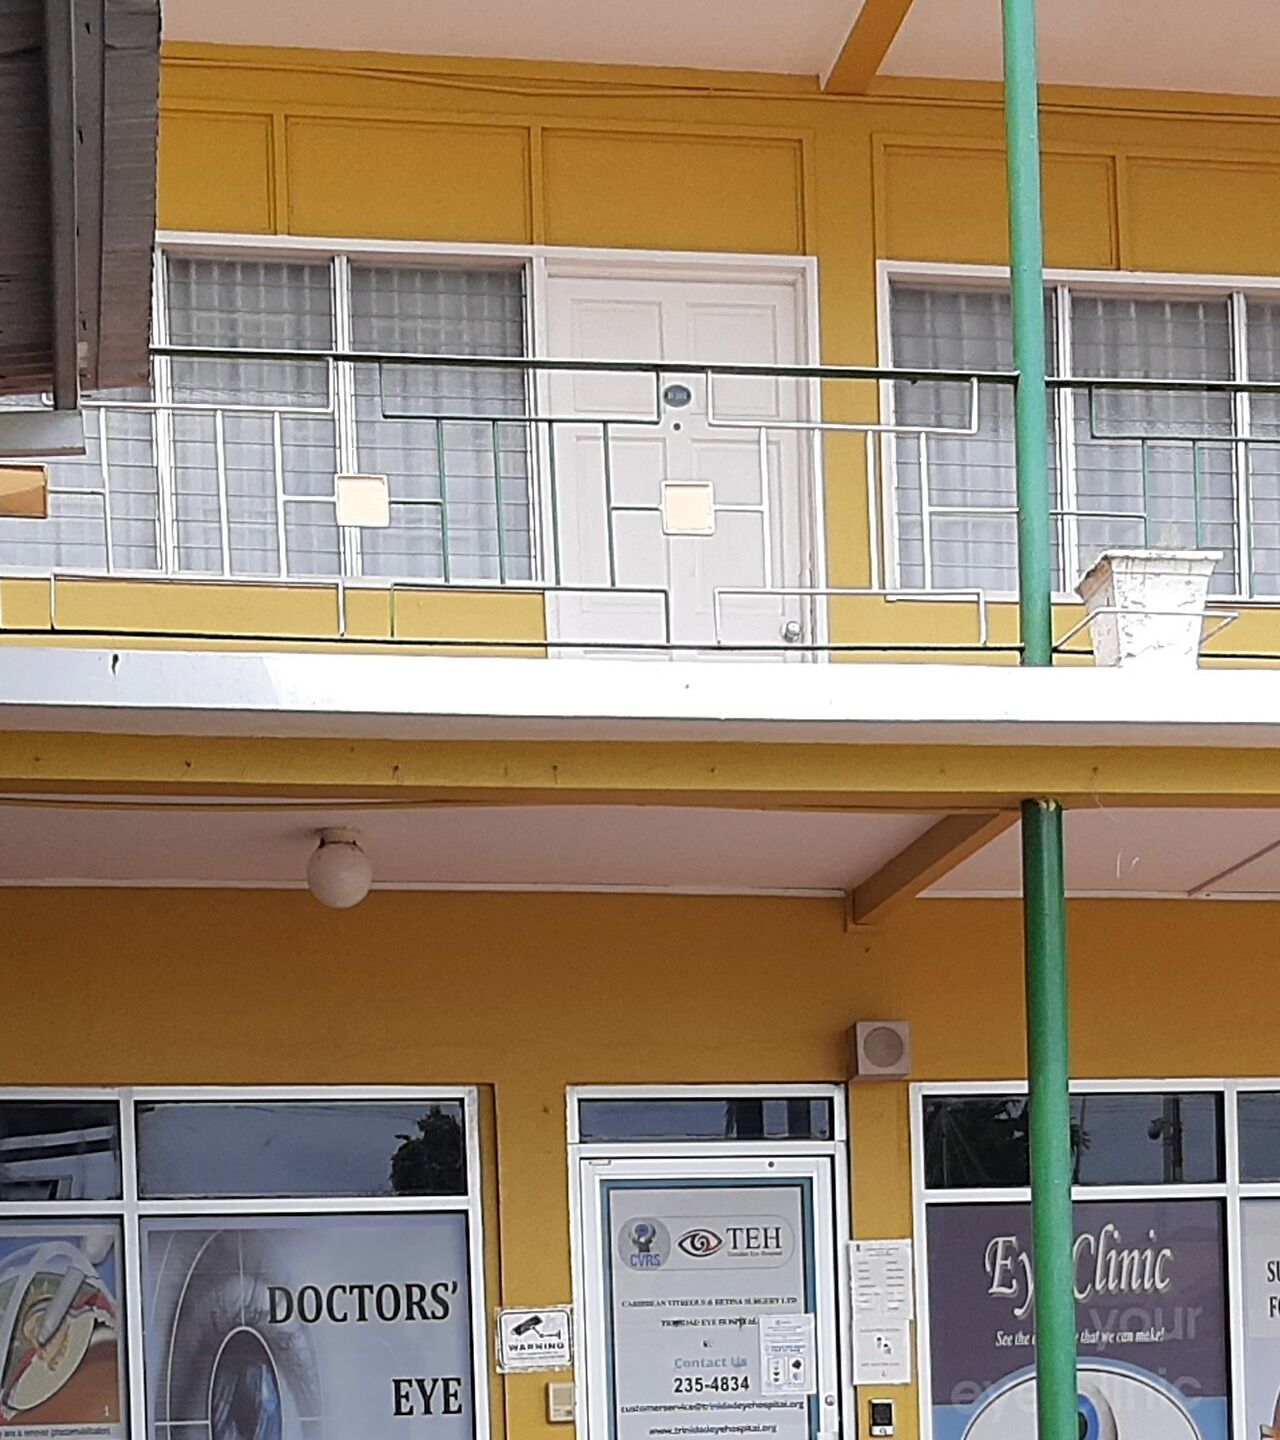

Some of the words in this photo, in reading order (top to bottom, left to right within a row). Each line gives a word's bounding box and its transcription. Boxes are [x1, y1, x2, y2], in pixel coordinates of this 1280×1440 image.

[726, 1226, 783, 1250] TEH
[630, 1254, 661, 1267] CVRS
[984, 1236, 1035, 1317] Ey
[1072, 1223, 1173, 1300] Clinic
[1090, 1306, 1203, 1350] your
[995, 1331, 1013, 1346] See
[1014, 1331, 1030, 1346] the
[1080, 1329, 1100, 1343] that
[1101, 1332, 1114, 1343] we
[1116, 1331, 1133, 1343] can
[508, 1342, 564, 1351] WARNING
[674, 1358, 727, 1369] Contact
[731, 1357, 748, 1368] Us
[674, 1376, 750, 1393] 235-4834
[392, 1377, 462, 1416] EYE
